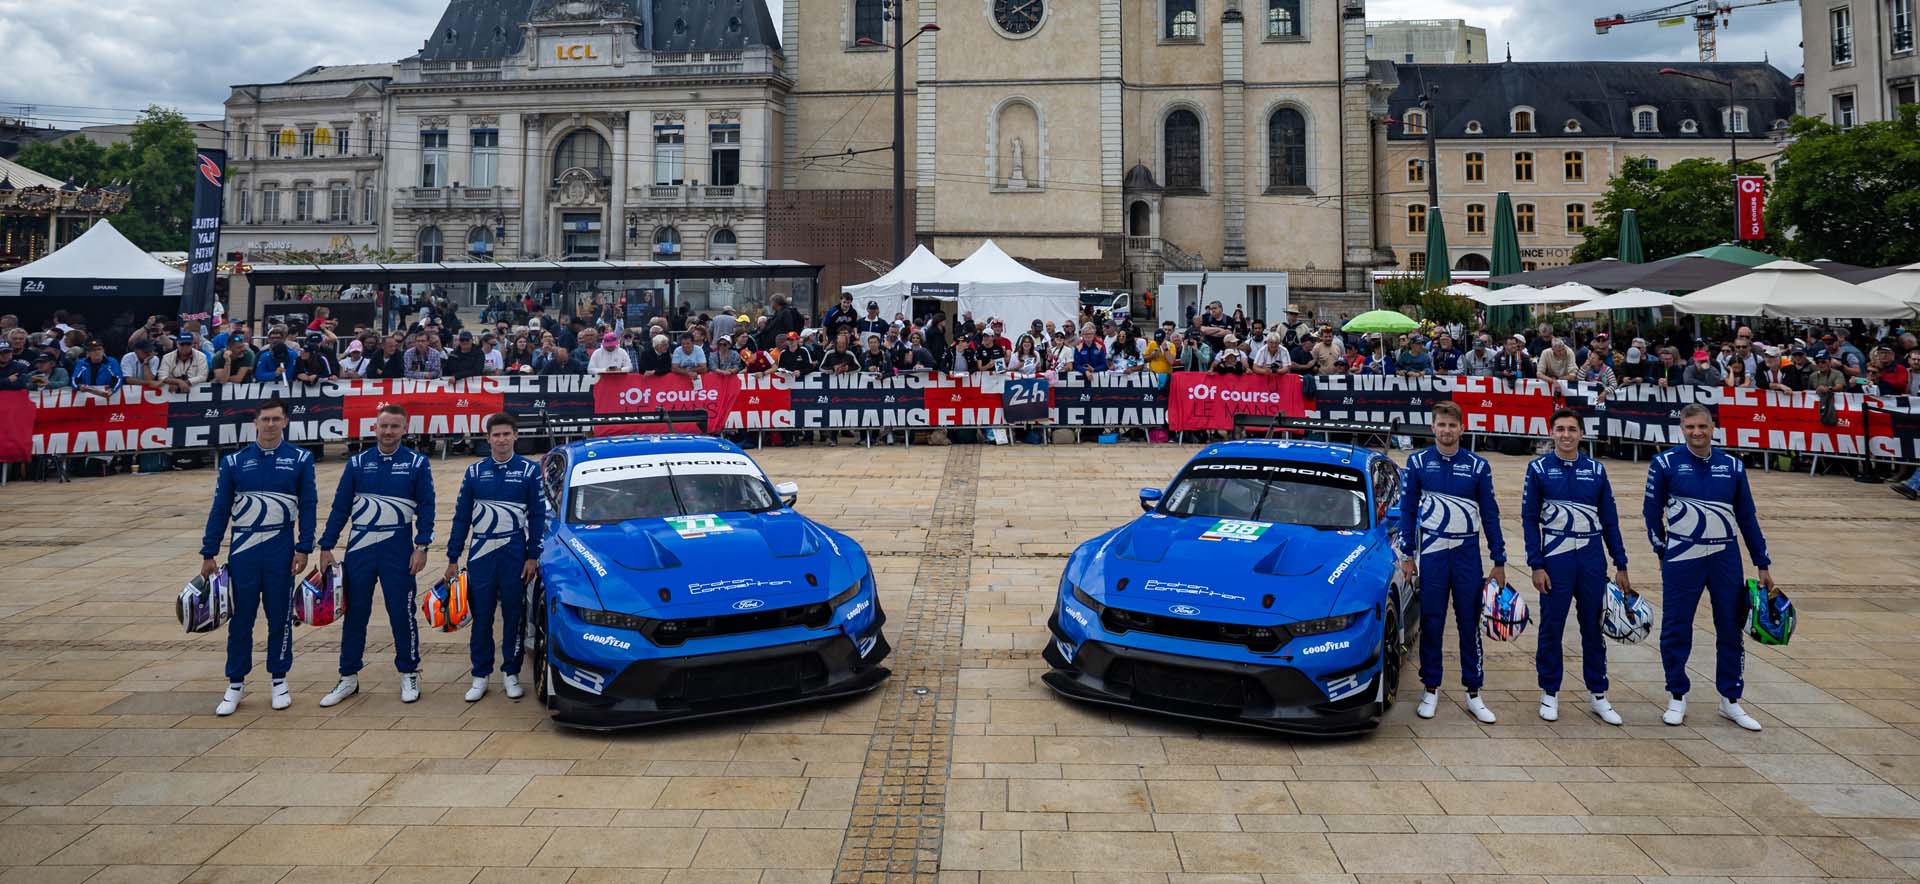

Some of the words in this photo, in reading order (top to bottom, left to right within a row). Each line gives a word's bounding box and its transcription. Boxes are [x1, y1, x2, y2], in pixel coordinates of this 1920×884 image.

[557, 44, 598, 59] LCL
[1090, 371, 1160, 388] MAN
[1353, 375, 1453, 392] MANS
[221, 379, 345, 400] MANS
[656, 389, 718, 403] course
[1187, 384, 1217, 400] :Of
[1220, 389, 1281, 404] course
[725, 410, 791, 430] ANS
[829, 409, 927, 428] MANS
[1090, 408, 1168, 425] MAN
[219, 419, 344, 443] MNS
[1292, 421, 1391, 430] MUSTANG
[1768, 430, 1894, 457] MANS
[582, 463, 653, 475] FORD
[659, 460, 748, 468] RACING
[1263, 466, 1358, 482] RACING
[1217, 523, 1260, 535] 88
[569, 538, 585, 554] FORD
[582, 547, 607, 577] RACING
[1328, 562, 1347, 585] FORD
[1345, 544, 1366, 569] RACING
[688, 578, 753, 591] Proton
[690, 580, 792, 595] Competition
[1146, 580, 1209, 591] Proton
[1144, 585, 1246, 601] Competition
[583, 633, 631, 650] GOODYEAR
[1303, 640, 1350, 655] GOODYEAR
